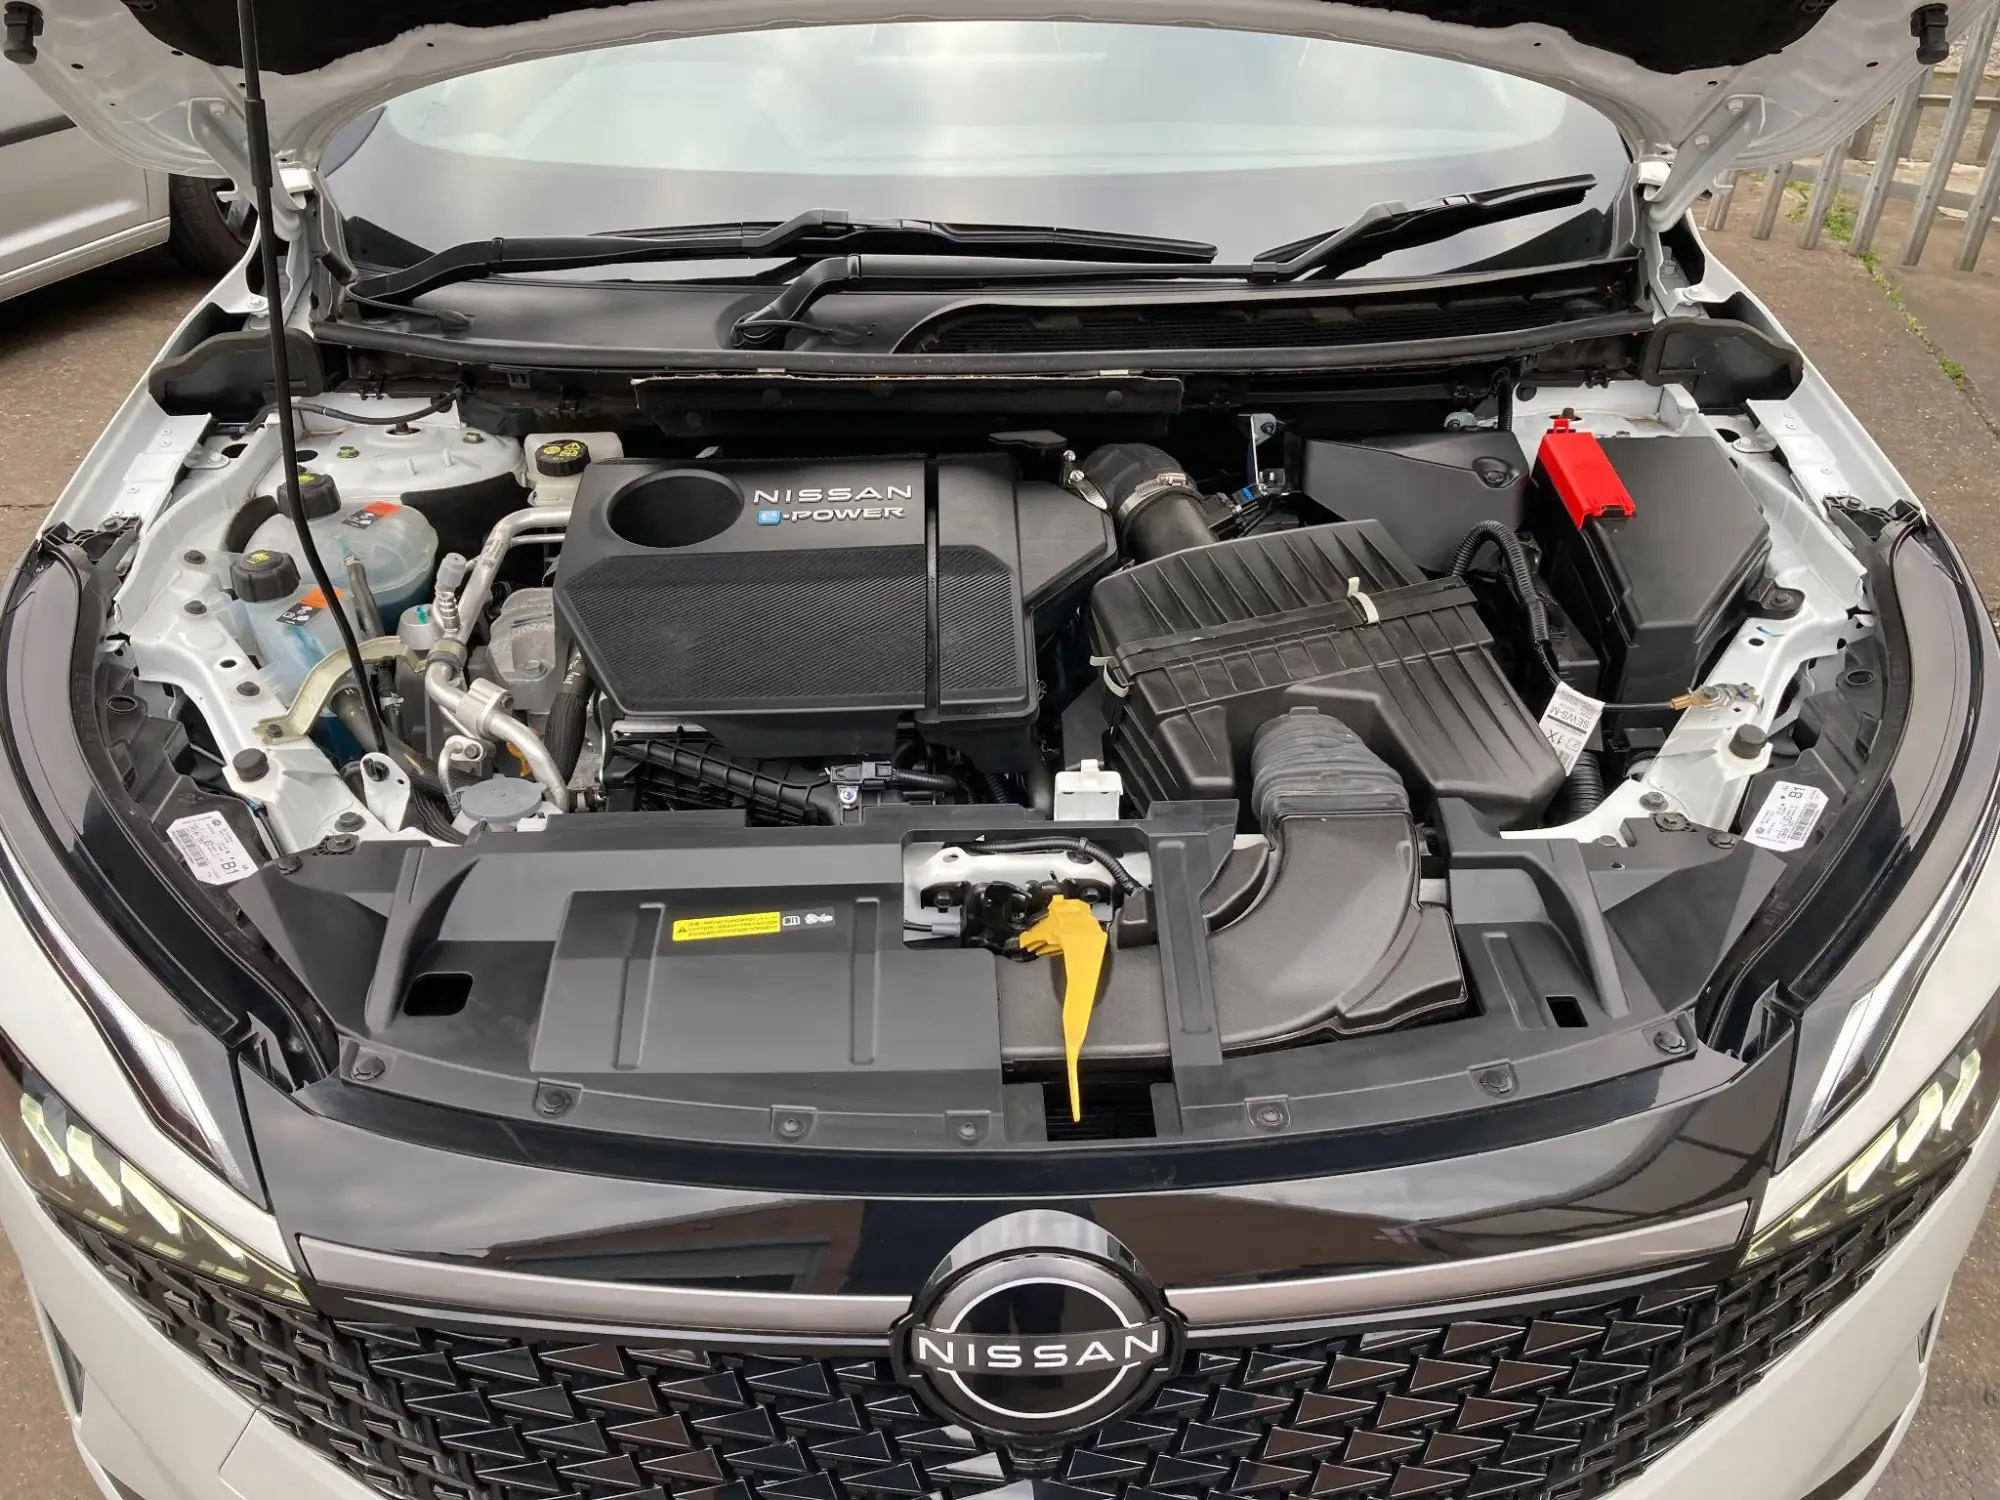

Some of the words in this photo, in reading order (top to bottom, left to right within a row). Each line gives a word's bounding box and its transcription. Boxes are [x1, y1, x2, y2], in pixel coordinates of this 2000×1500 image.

[753, 485, 912, 504] NISSAN
[757, 507, 907, 525] e-POWER
[1550, 705, 1590, 729] SEWS-M
[1547, 729, 1563, 745] 1X
[1788, 787, 1806, 799] B1
[221, 861, 239, 874] B1
[918, 1329, 1159, 1368] NISSAN
